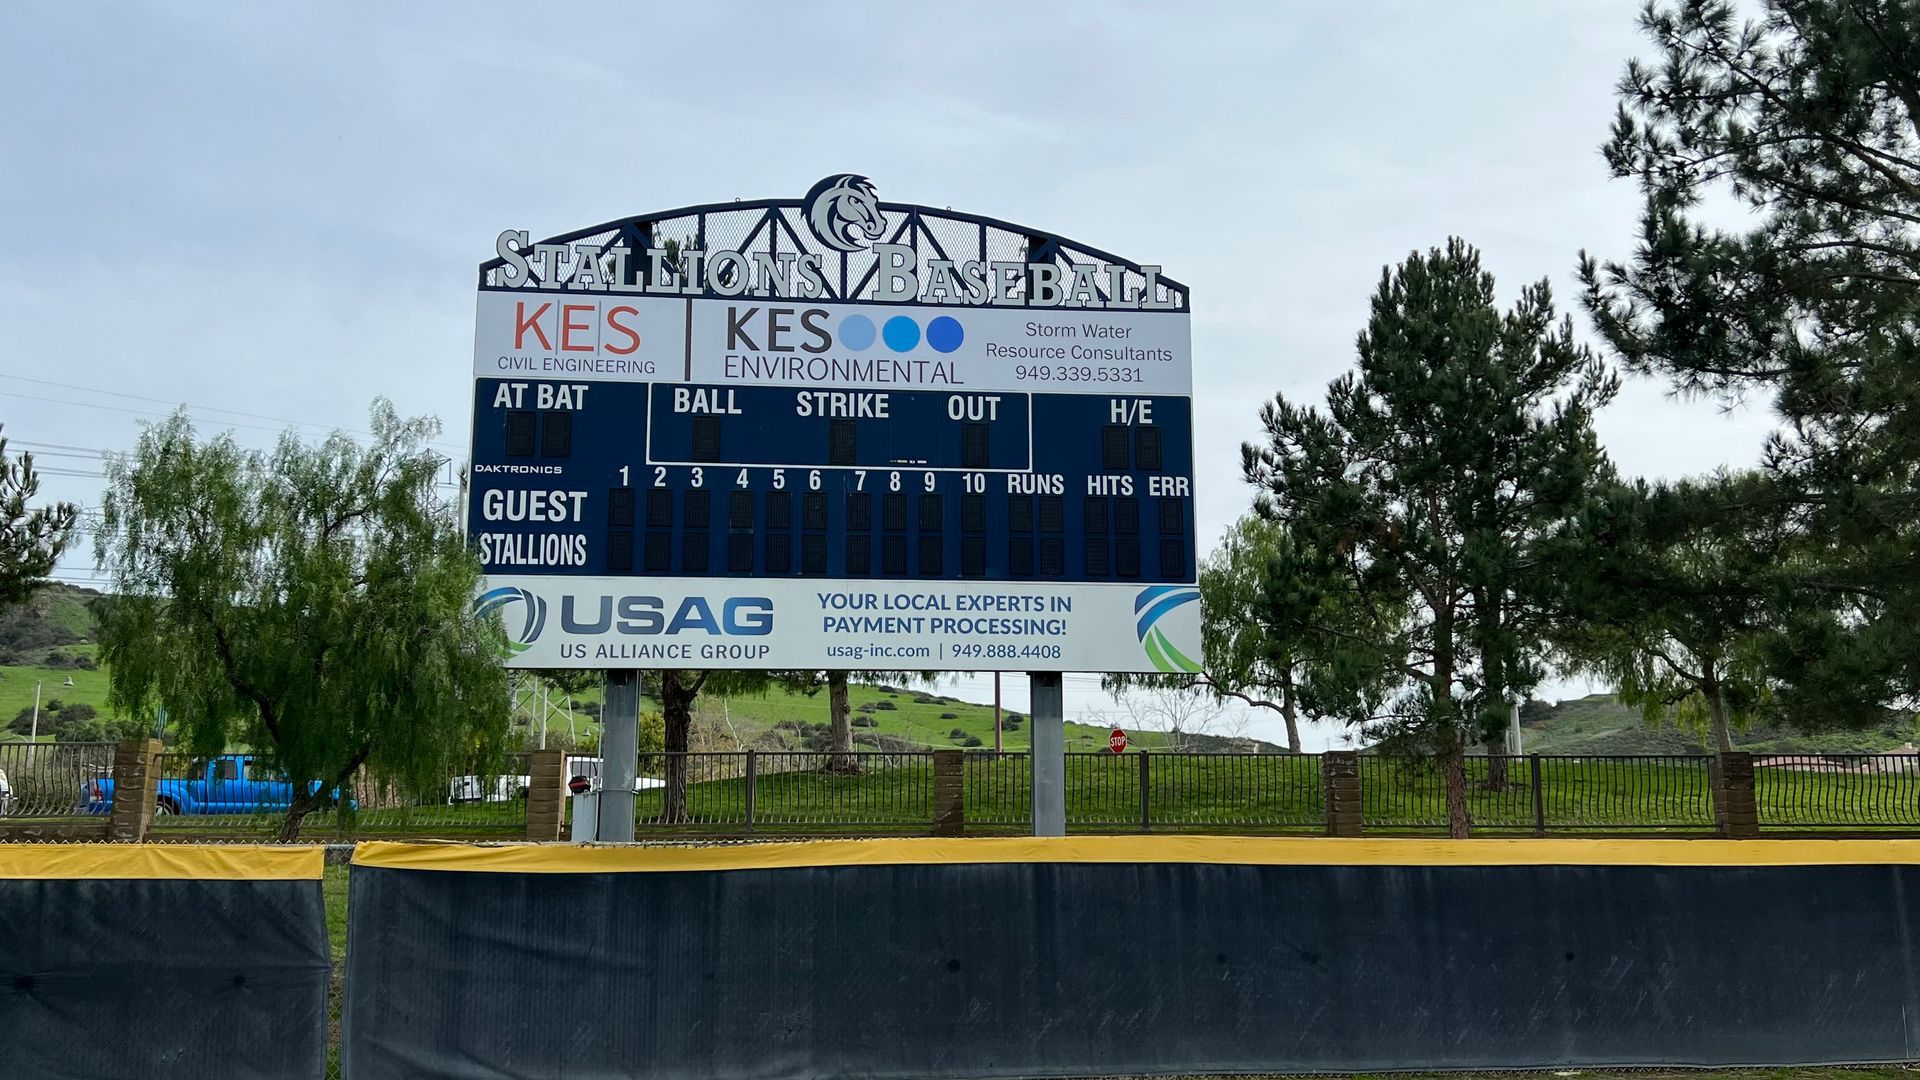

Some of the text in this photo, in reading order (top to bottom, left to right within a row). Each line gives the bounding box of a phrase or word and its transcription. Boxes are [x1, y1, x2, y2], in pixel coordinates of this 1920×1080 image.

[496, 229, 1175, 309] STALLIONS BASEBALL
[514, 301, 641, 355] KES
[727, 306, 833, 353] KES
[1025, 322, 1132, 340] Storm Water
[498, 356, 656, 374] CIVIL ENGINEERING
[986, 343, 1173, 362] Resource Consultants
[724, 355, 964, 385] ENVIRONMENTAL
[1015, 365, 1144, 383] 949.339.5331
[493, 382, 589, 410] AT BAT
[674, 388, 742, 415] BALL
[796, 391, 889, 418] STRIKE
[948, 395, 1001, 421] OUT
[1110, 399, 1153, 426] H/E
[475, 464, 562, 474] DAKTRONICS
[619, 465, 1190, 497] 1 2 3 4 5 6 7 8 9 10 RUNS HITS ERR
[483, 489, 587, 522] GUEST
[479, 533, 586, 567] STALLIONS
[561, 595, 774, 636] USAG
[817, 593, 1072, 613] YOUR LOCAL EXPERTS IN
[823, 616, 1067, 635] PAYMENT PROCESSING!
[561, 643, 770, 660] US ALLIANCE GROUP
[827, 642, 1061, 659] usag-inc.com 949.888.4408
[1110, 736, 1126, 747] STOP
